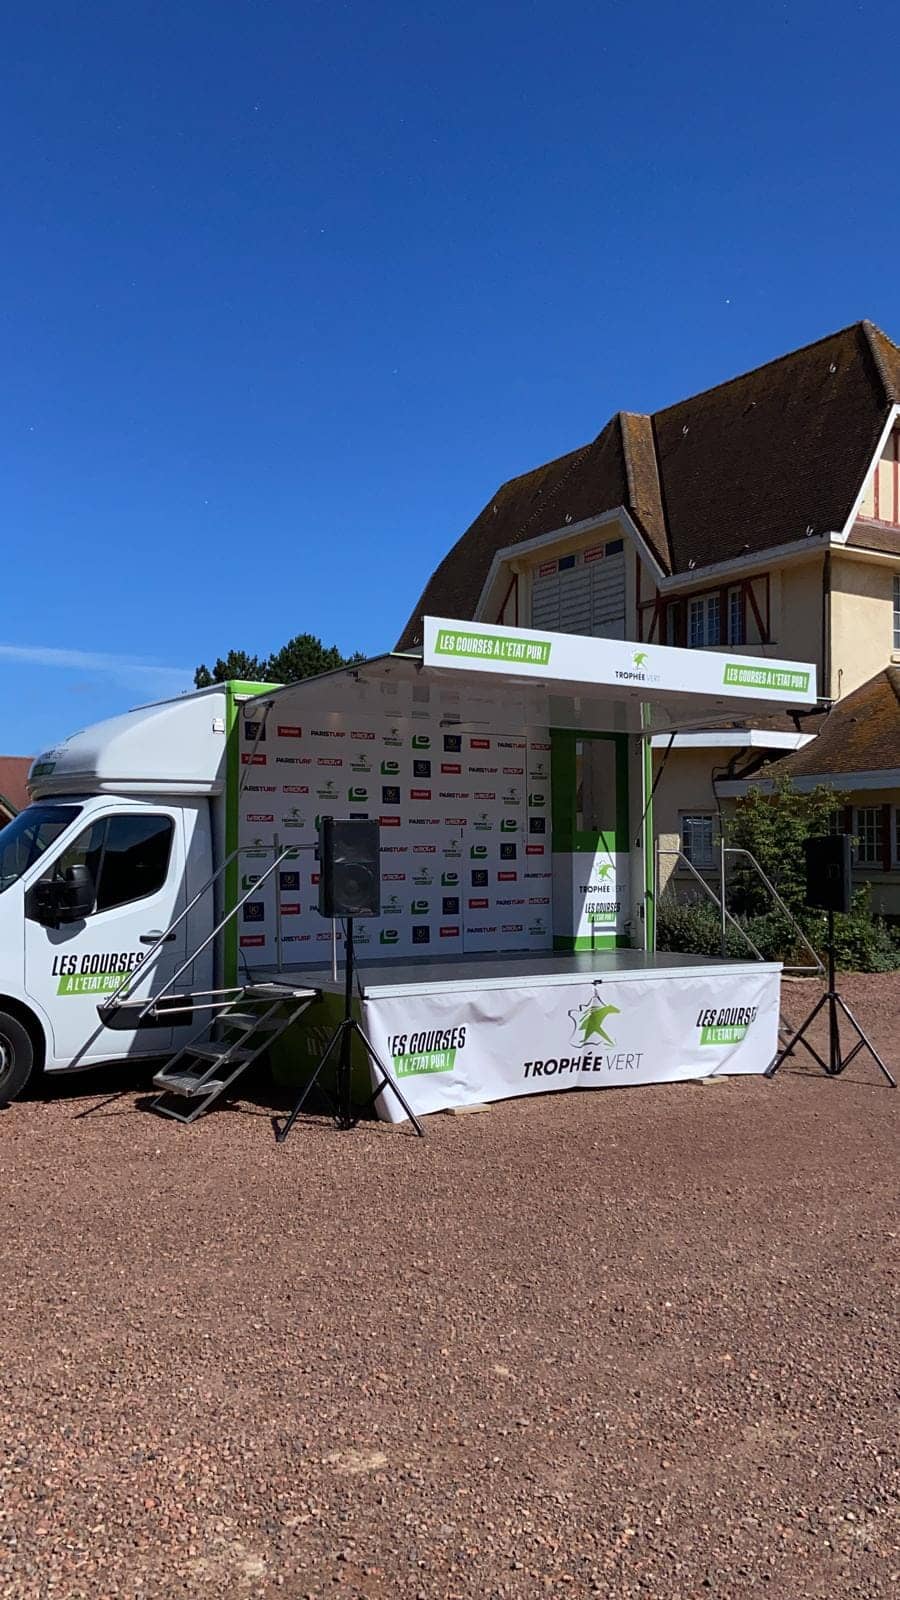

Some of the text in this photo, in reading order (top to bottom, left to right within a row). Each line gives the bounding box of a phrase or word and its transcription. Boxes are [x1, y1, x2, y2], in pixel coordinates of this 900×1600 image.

[440, 634, 455, 650] LES
[456, 637, 494, 655] COURSES
[501, 641, 526, 657] L'ETAT
[526, 645, 543, 660] PUR
[726, 668, 738, 682] LES
[739, 669, 767, 685] COURSES
[311, 730, 346, 738] PARISTURF
[275, 757, 312, 765] PARISTURF
[52, 952, 145, 976] LES COURSES
[74, 976, 103, 991] L'ETAT
[103, 975, 120, 989] PUR
[696, 1009, 717, 1027] LES
[409, 1027, 466, 1055] COURSES
[404, 1055, 430, 1073] L'ETAT
[430, 1053, 446, 1069] PUR
[523, 1051, 644, 1078] TROPHÉE VERT
